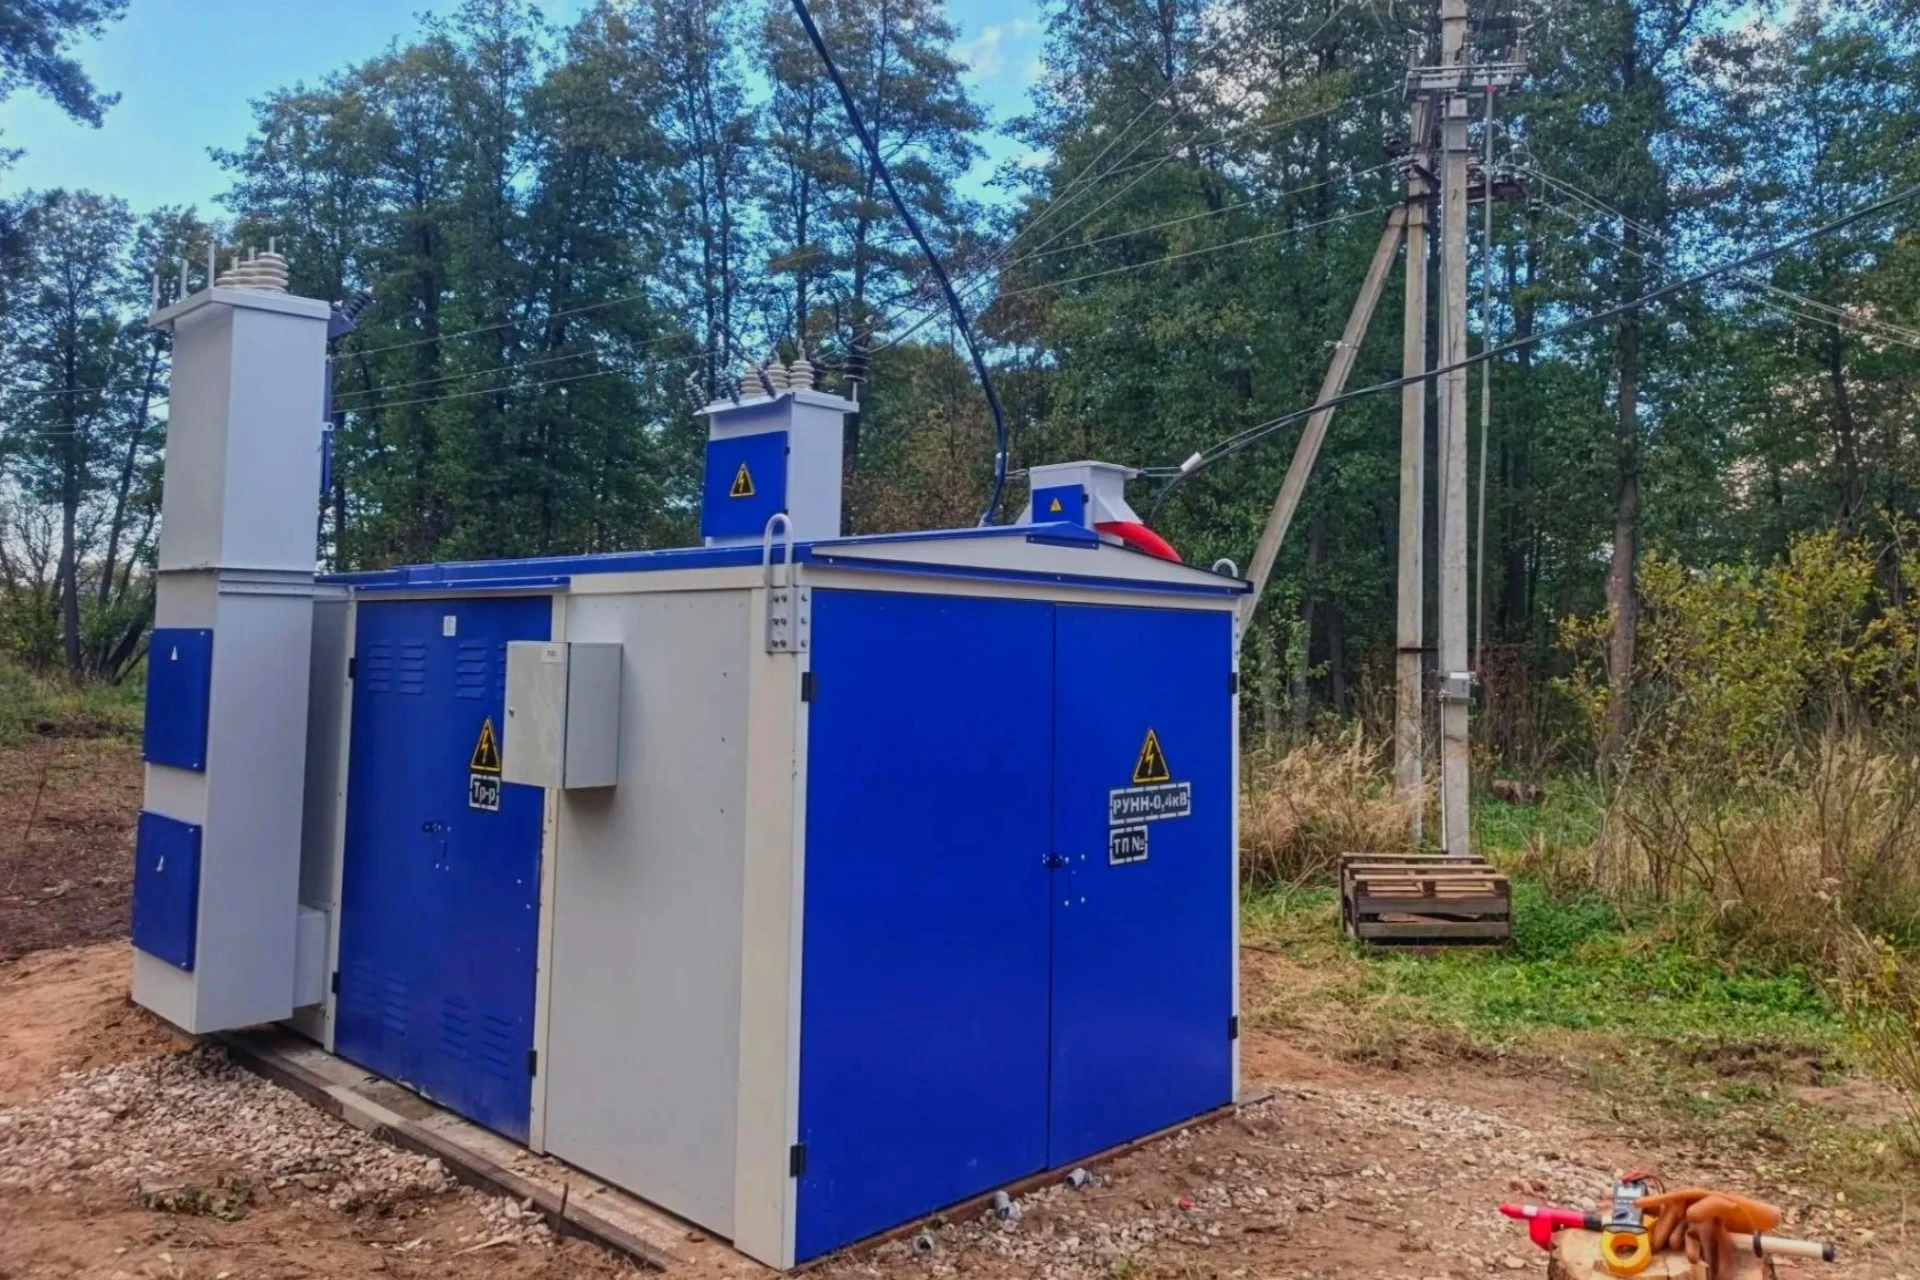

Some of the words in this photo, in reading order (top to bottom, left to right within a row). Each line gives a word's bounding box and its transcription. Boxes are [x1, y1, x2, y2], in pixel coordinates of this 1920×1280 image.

[473, 781, 496, 804] Тр-р
[1112, 792, 1188, 815] РУНН-0,4кВ
[1113, 837, 1129, 855] ТП
[1132, 836, 1145, 851] №
